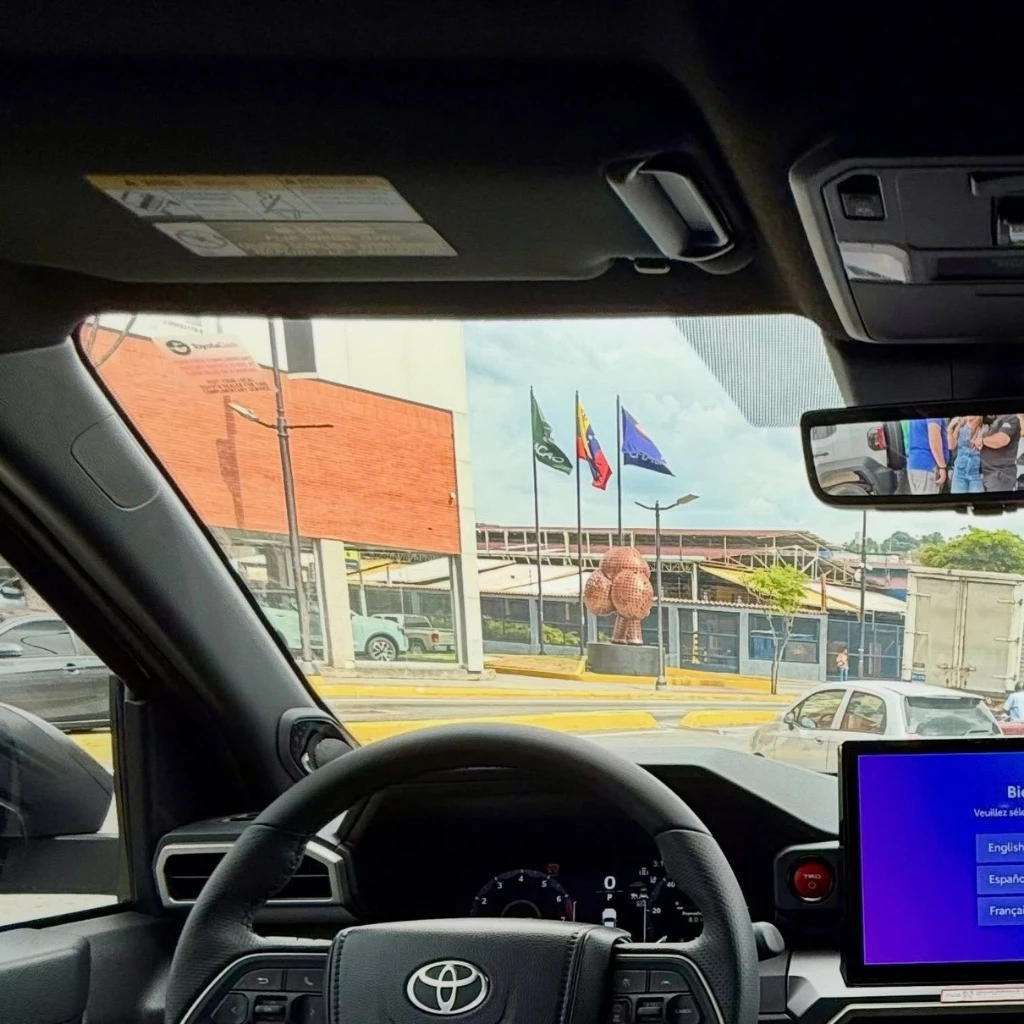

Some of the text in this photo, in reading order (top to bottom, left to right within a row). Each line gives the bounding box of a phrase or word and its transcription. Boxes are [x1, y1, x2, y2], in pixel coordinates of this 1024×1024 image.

[974, 808, 1008, 818] Veuillez
[988, 842, 1024, 855] English
[518, 874, 524, 882] 4
[497, 881, 503, 889] 3
[541, 879, 548, 888] 5
[603, 875, 617, 890] 0
[481, 897, 487, 905] 2
[556, 895, 562, 903] 6
